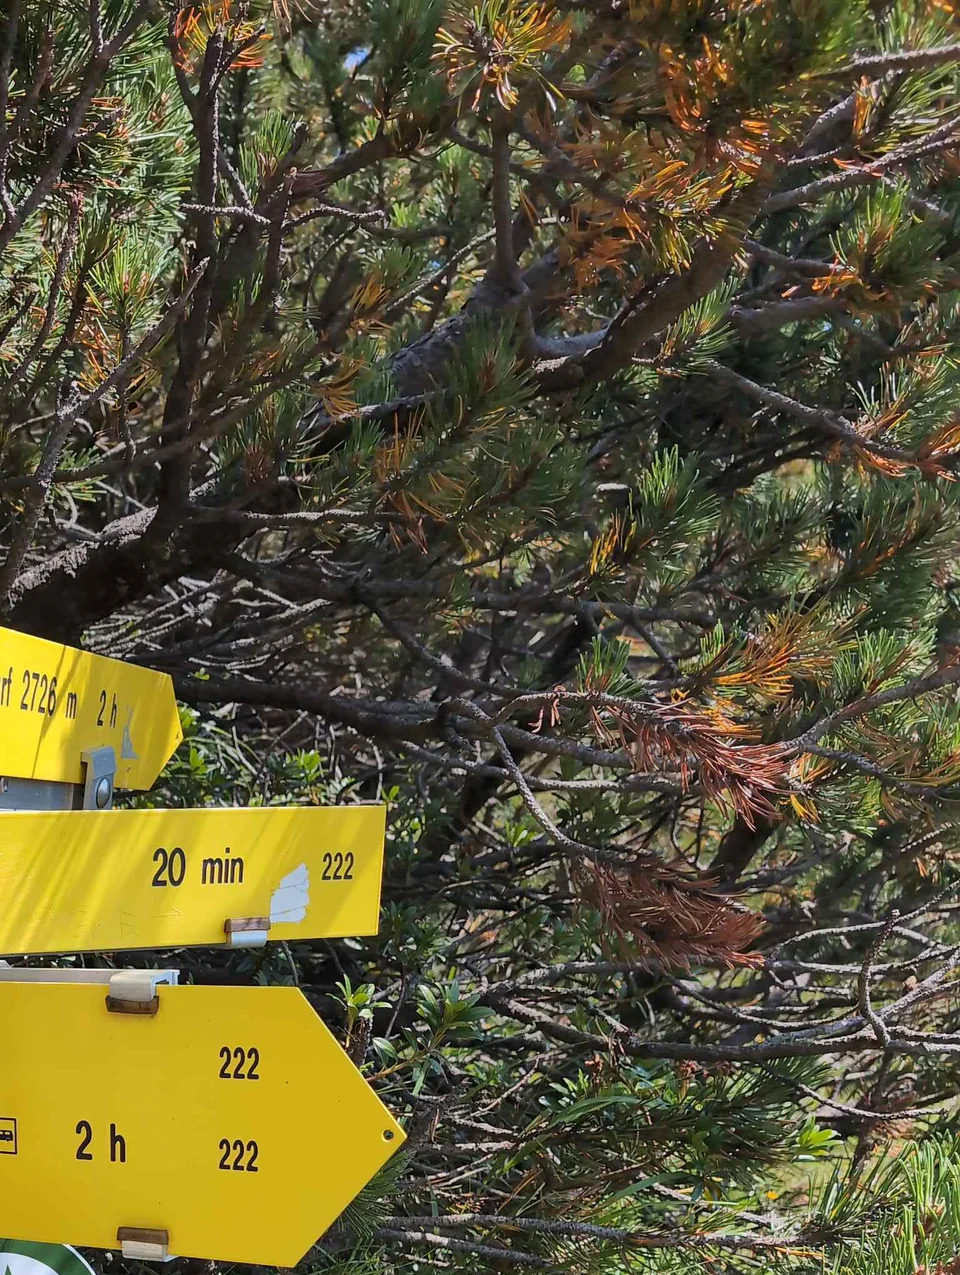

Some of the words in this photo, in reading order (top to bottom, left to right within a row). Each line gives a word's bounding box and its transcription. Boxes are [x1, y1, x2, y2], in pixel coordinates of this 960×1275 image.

[21, 669, 58, 717] 2726
[65, 691, 77, 720] m
[96, 689, 107, 727] 2
[109, 692, 117, 729] h
[151, 847, 187, 887] 20
[201, 847, 244, 885] min
[321, 851, 355, 881] 222
[219, 1046, 260, 1080] 222
[75, 1119, 93, 1161] 2
[109, 1123, 126, 1163] h
[218, 1138, 259, 1172] 222
